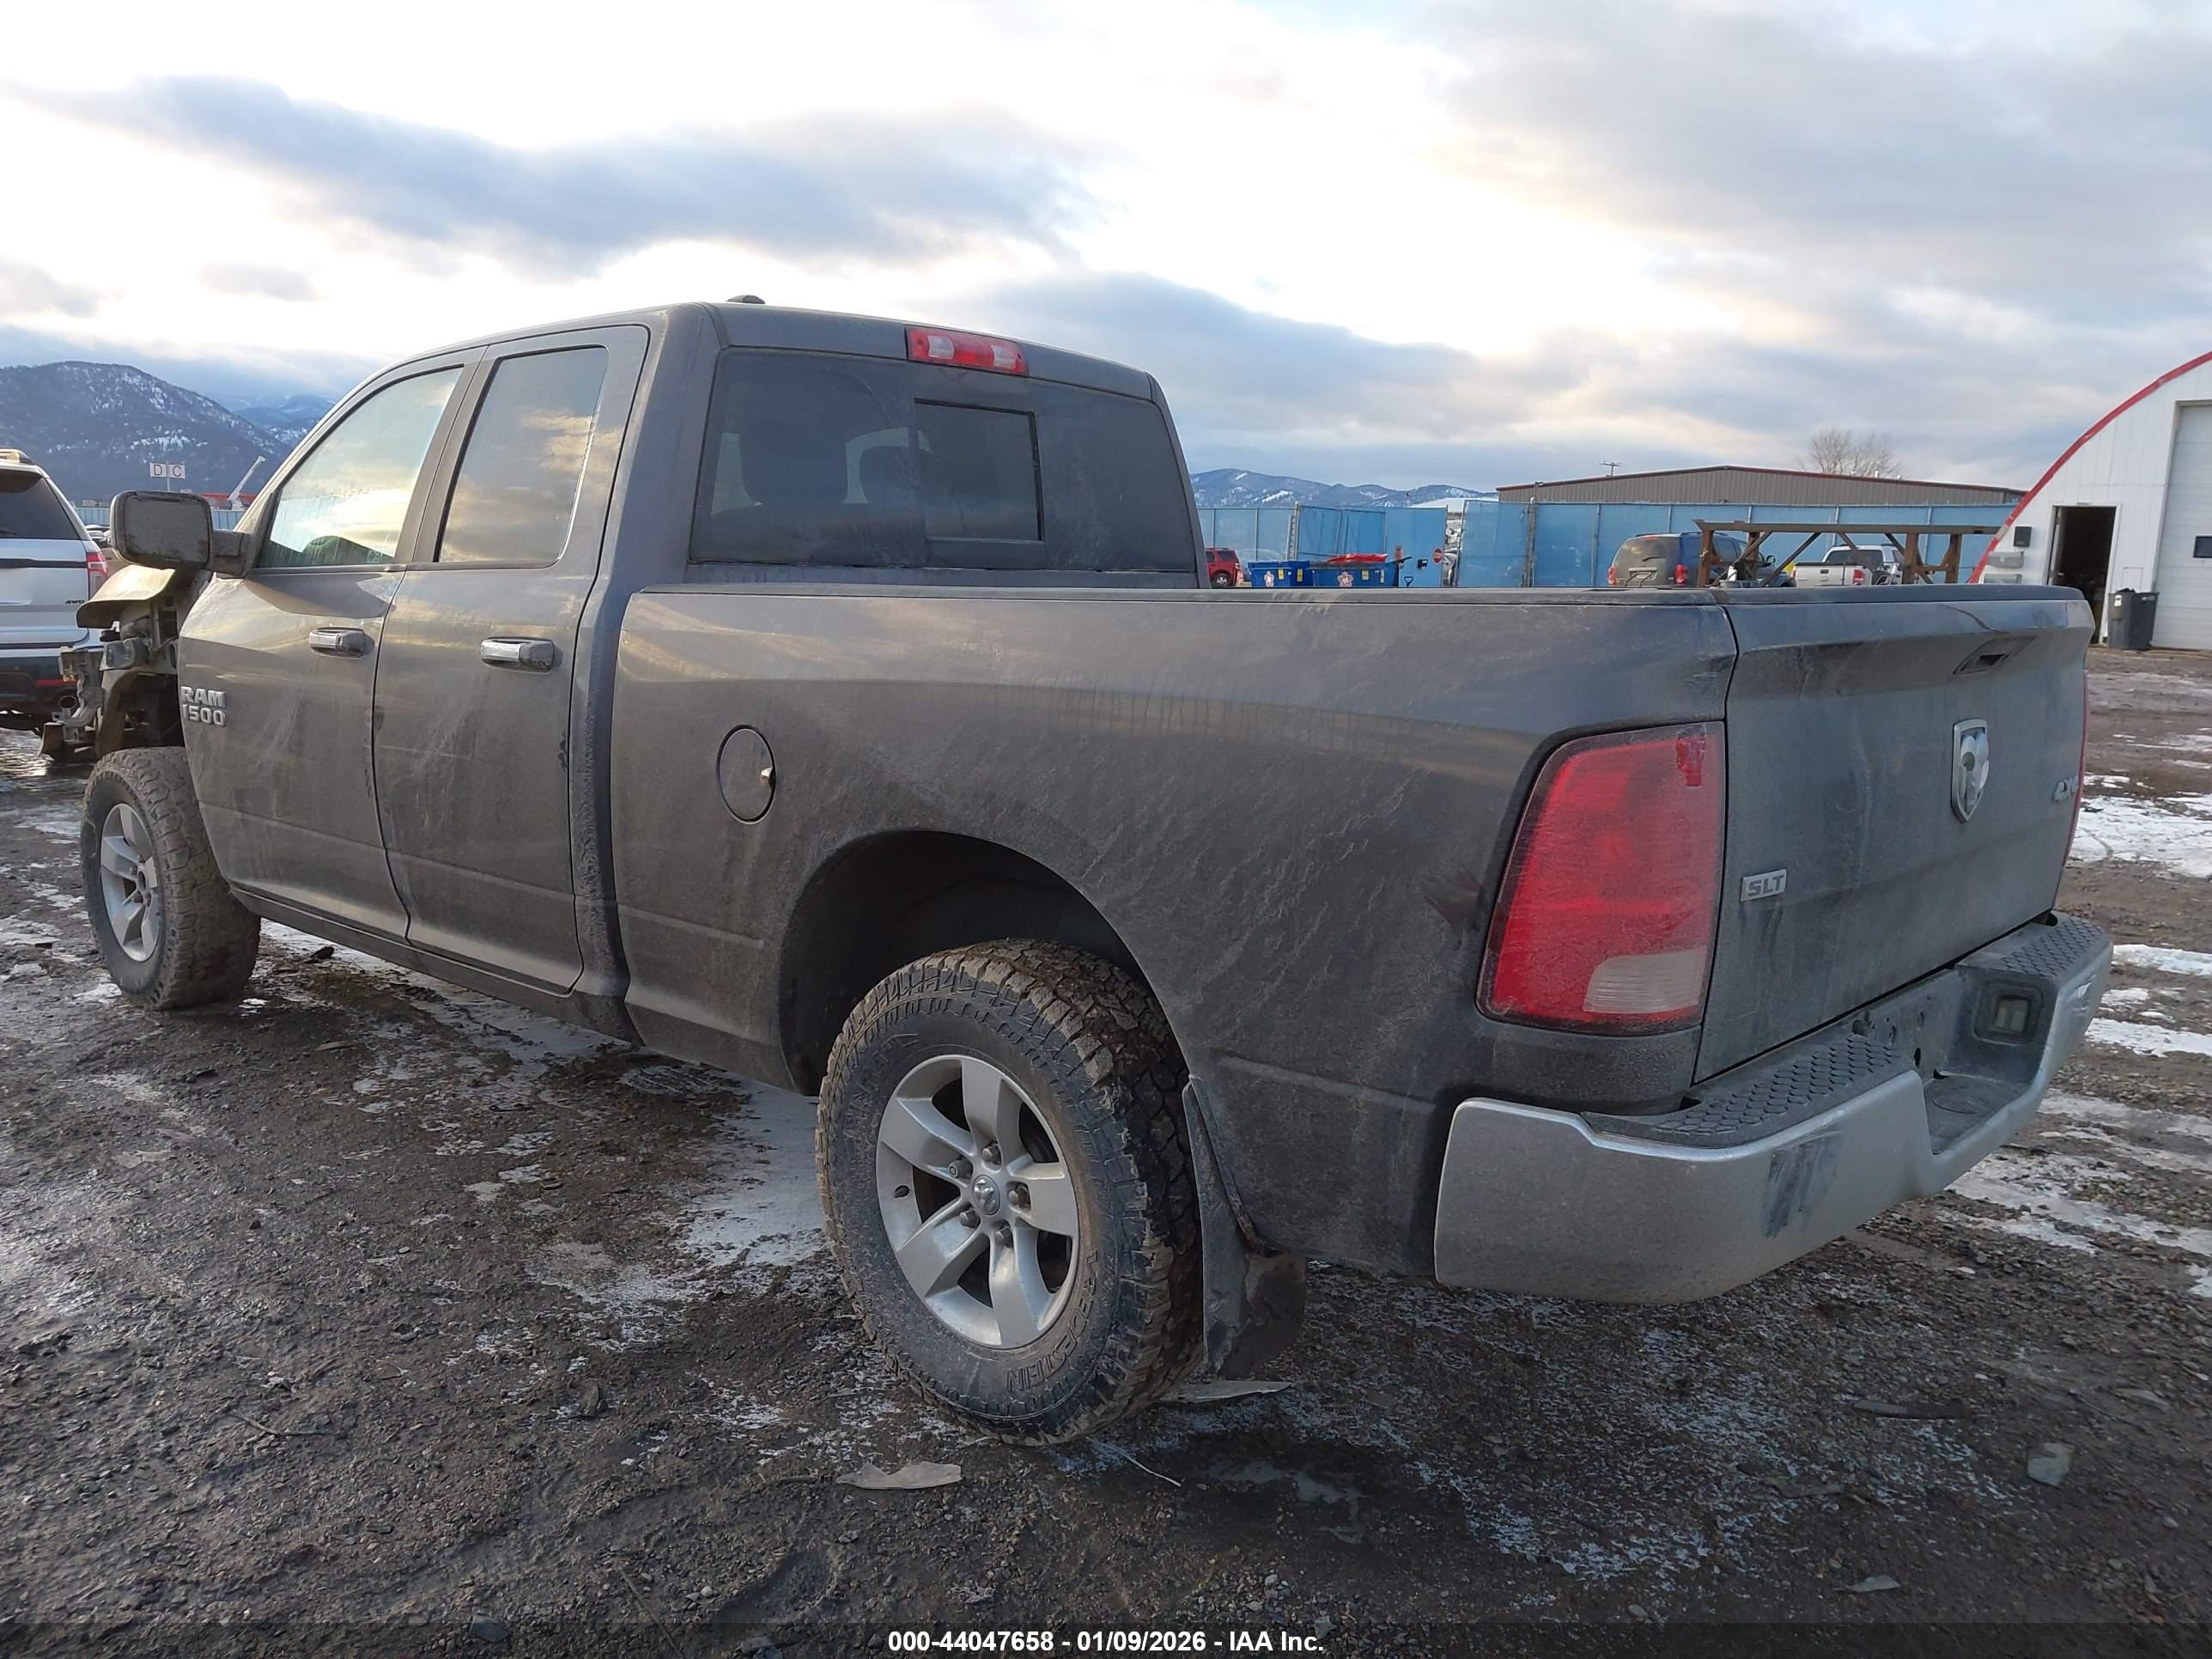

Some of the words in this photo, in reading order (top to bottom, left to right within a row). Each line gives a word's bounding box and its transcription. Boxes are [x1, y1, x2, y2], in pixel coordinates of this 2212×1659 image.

[154, 464, 163, 476] D
[172, 465, 182, 477] C
[180, 686, 226, 708] RAM
[181, 703, 226, 726] 1500
[1747, 874, 1785, 896] SLT
